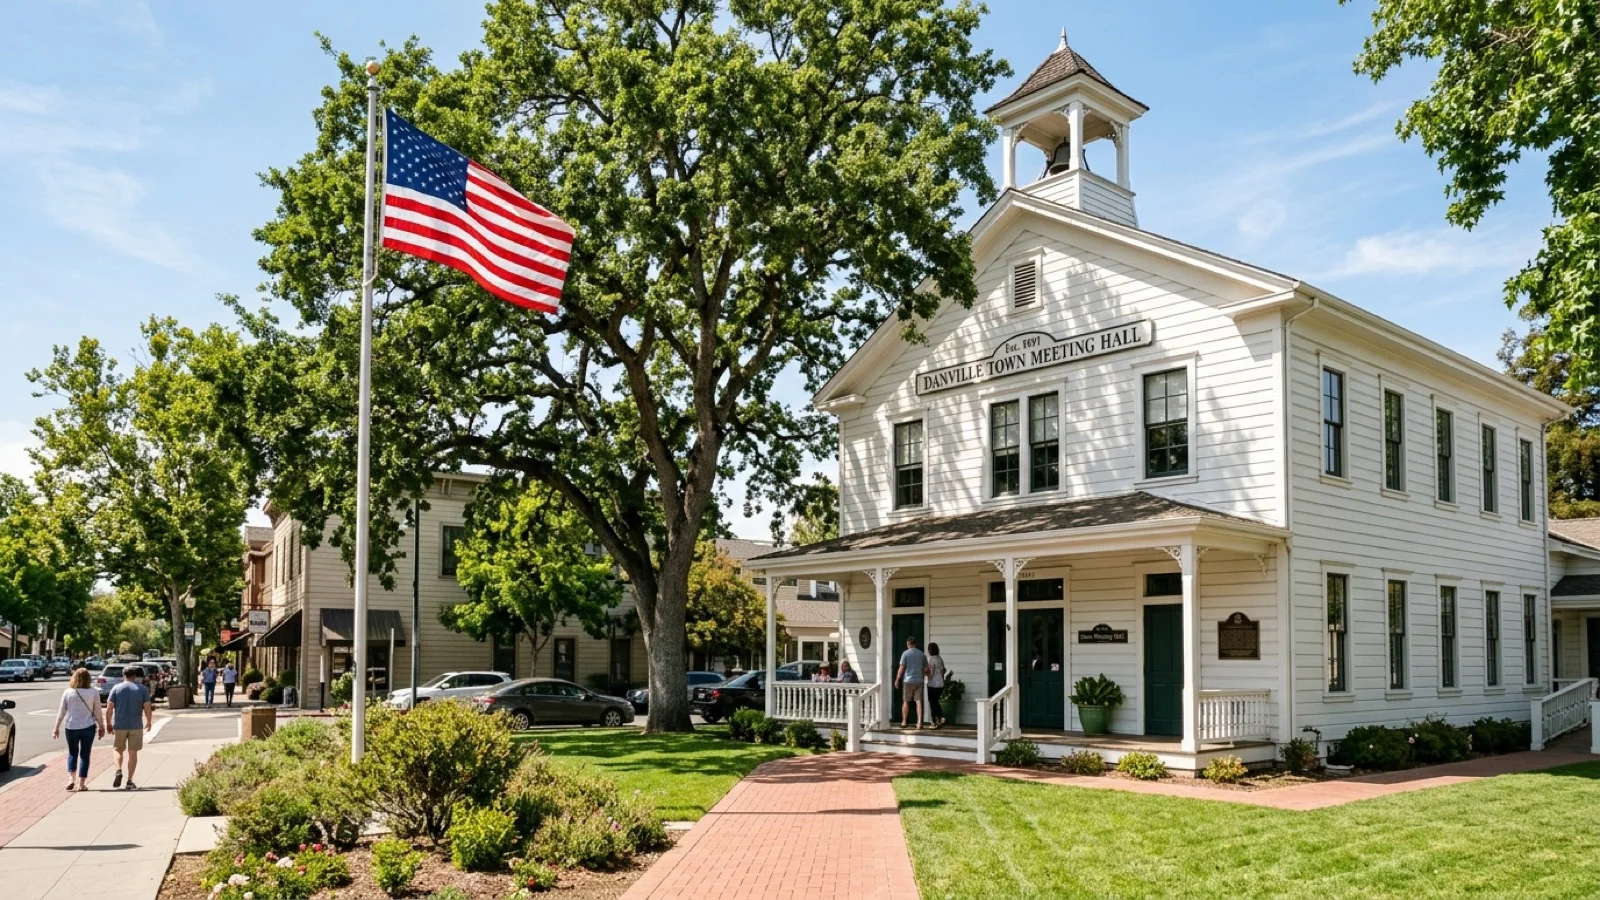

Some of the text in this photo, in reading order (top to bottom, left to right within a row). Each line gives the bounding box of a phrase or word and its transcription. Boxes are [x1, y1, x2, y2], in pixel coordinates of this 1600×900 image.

[923, 326, 1142, 390] DANVILLE TOWN MEETING HALL
